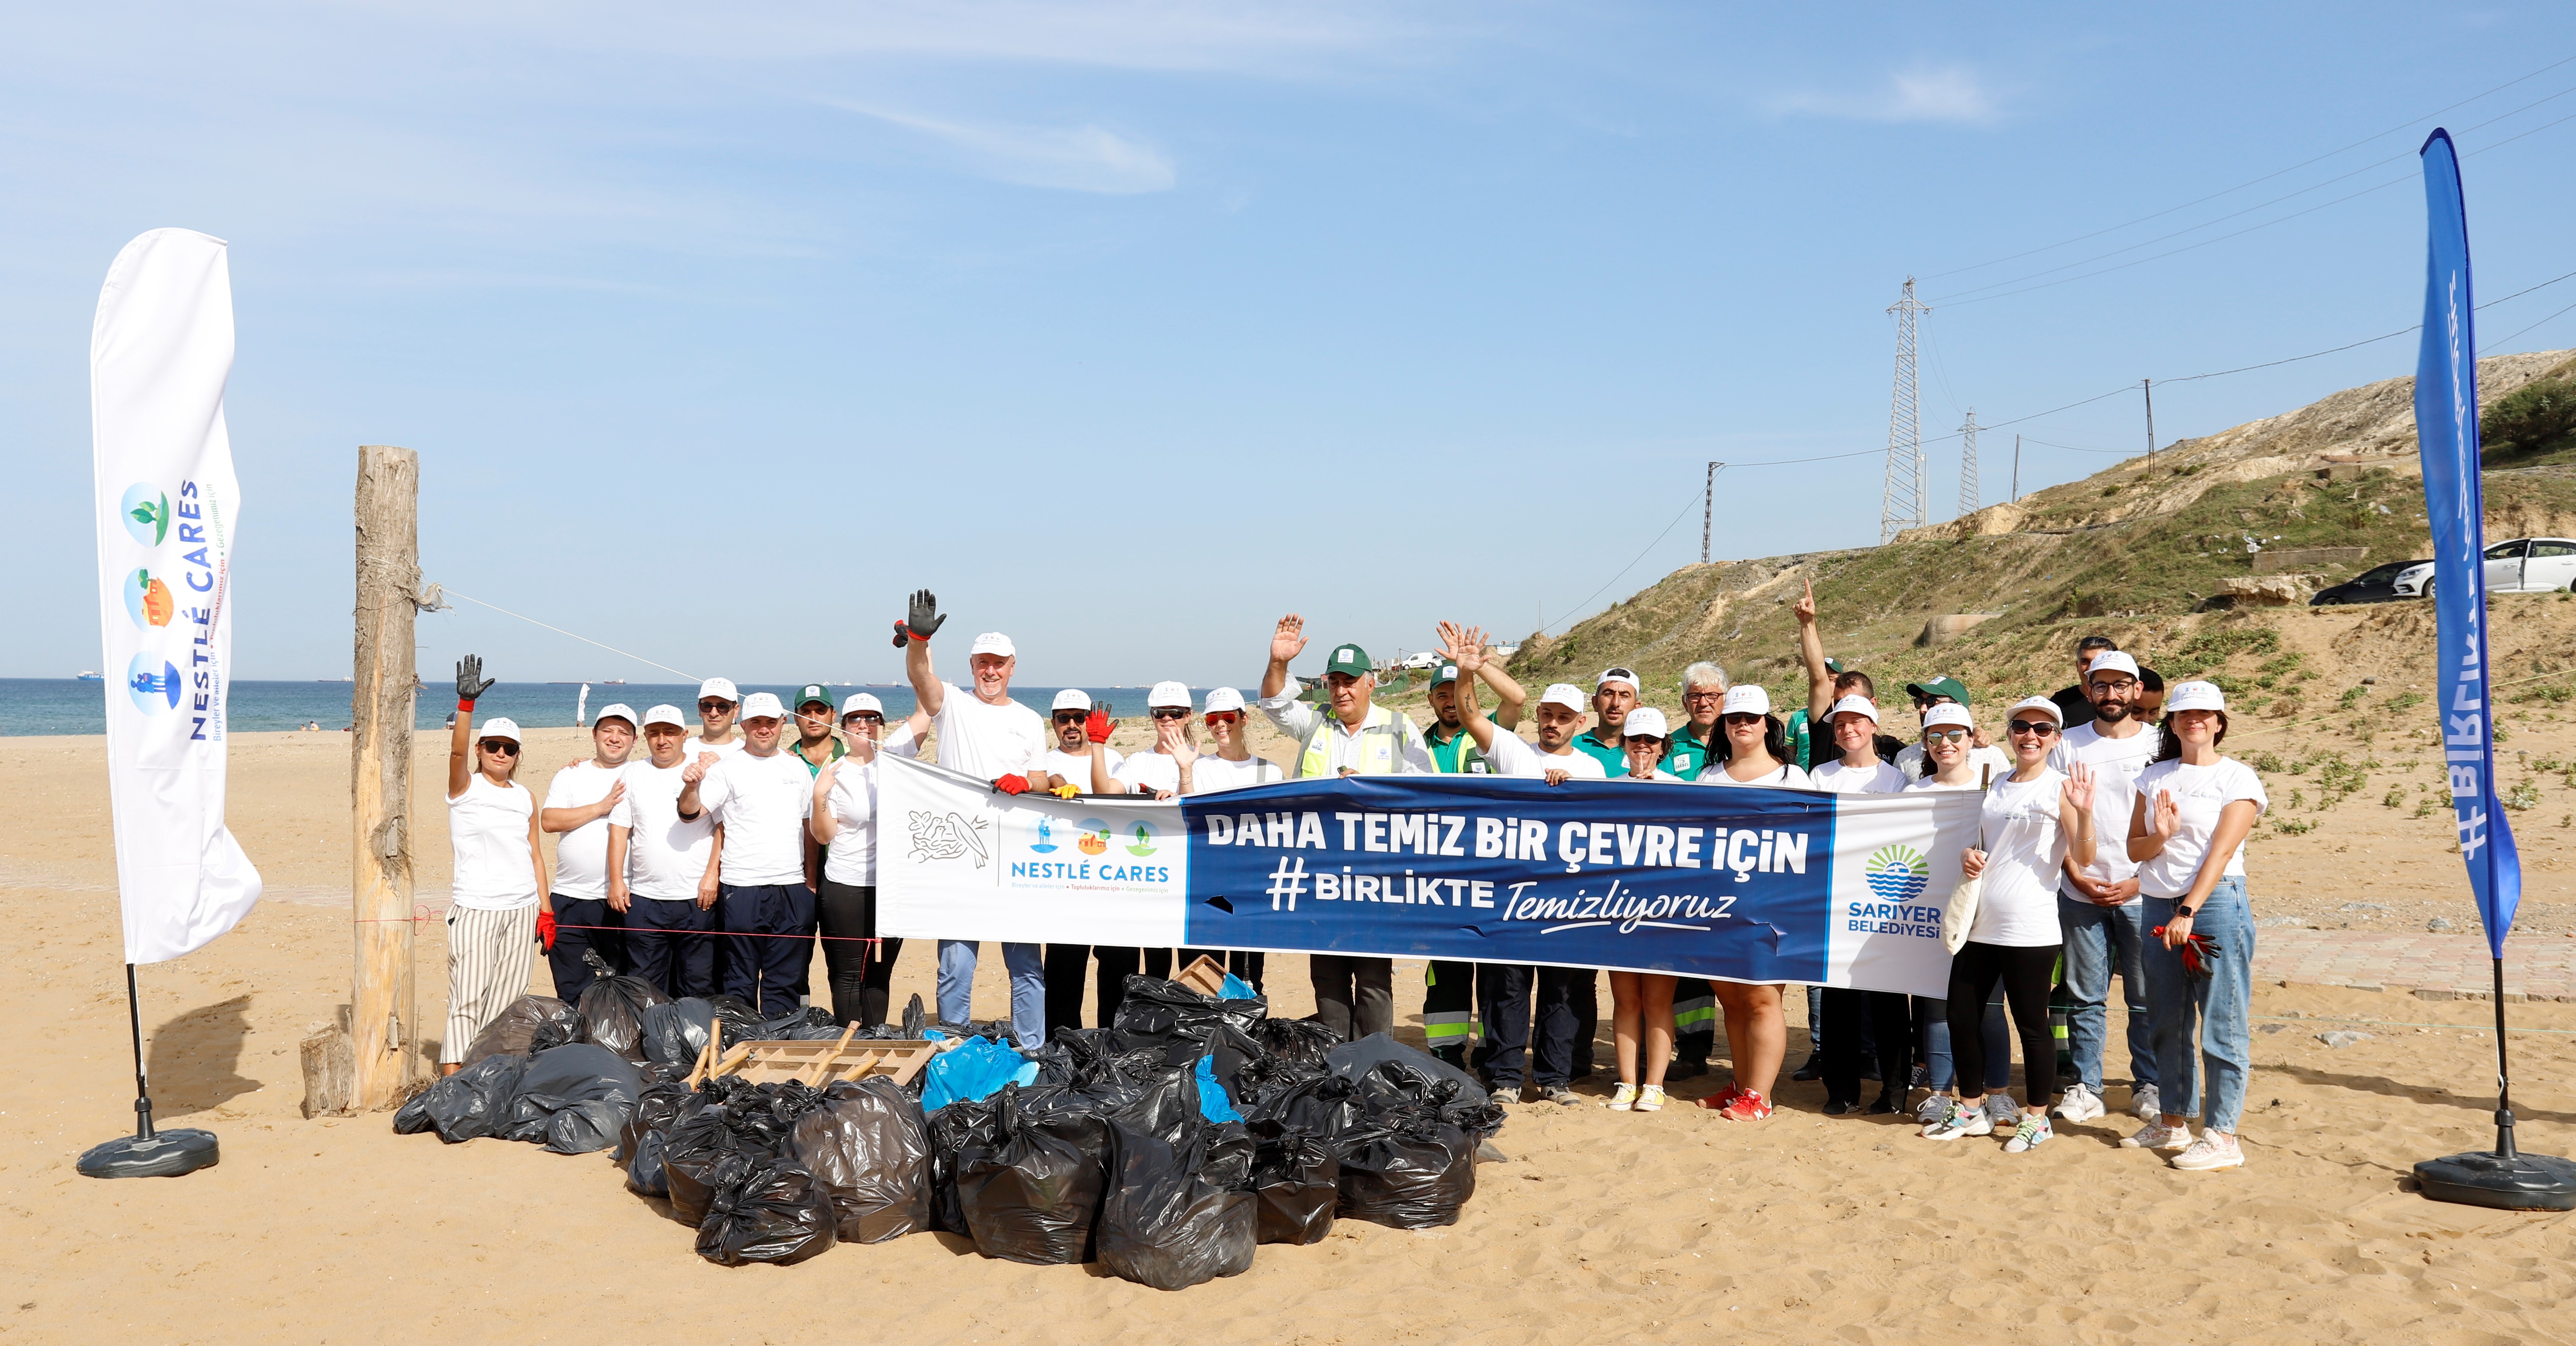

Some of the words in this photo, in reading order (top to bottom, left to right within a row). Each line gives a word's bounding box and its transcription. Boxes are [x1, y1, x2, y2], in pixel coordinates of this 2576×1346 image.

[205, 484, 217, 498] için
[178, 480, 213, 592] CARES
[208, 499, 225, 548] Gezegenimiz
[210, 576, 224, 641] Tluluklarımız
[182, 607, 209, 741] NESTLÉ
[208, 652, 218, 667] için
[210, 669, 219, 695] aileler
[212, 696, 219, 708] ve
[211, 709, 221, 741] Bireyler
[1205, 812, 1327, 849] DAHA
[1335, 812, 1465, 856] TEMİZ
[1475, 817, 1548, 861] BİR
[1559, 822, 1703, 873] ÇEVRE
[1713, 827, 1808, 883] İÇİN
[1012, 859, 1090, 879] NESTLÉ
[1099, 865, 1169, 882] CARES
[1502, 879, 1737, 934] Temizliyoruz
[1848, 902, 1941, 924] SARIYER
[1848, 920, 1940, 939] BELEDİYESİ
